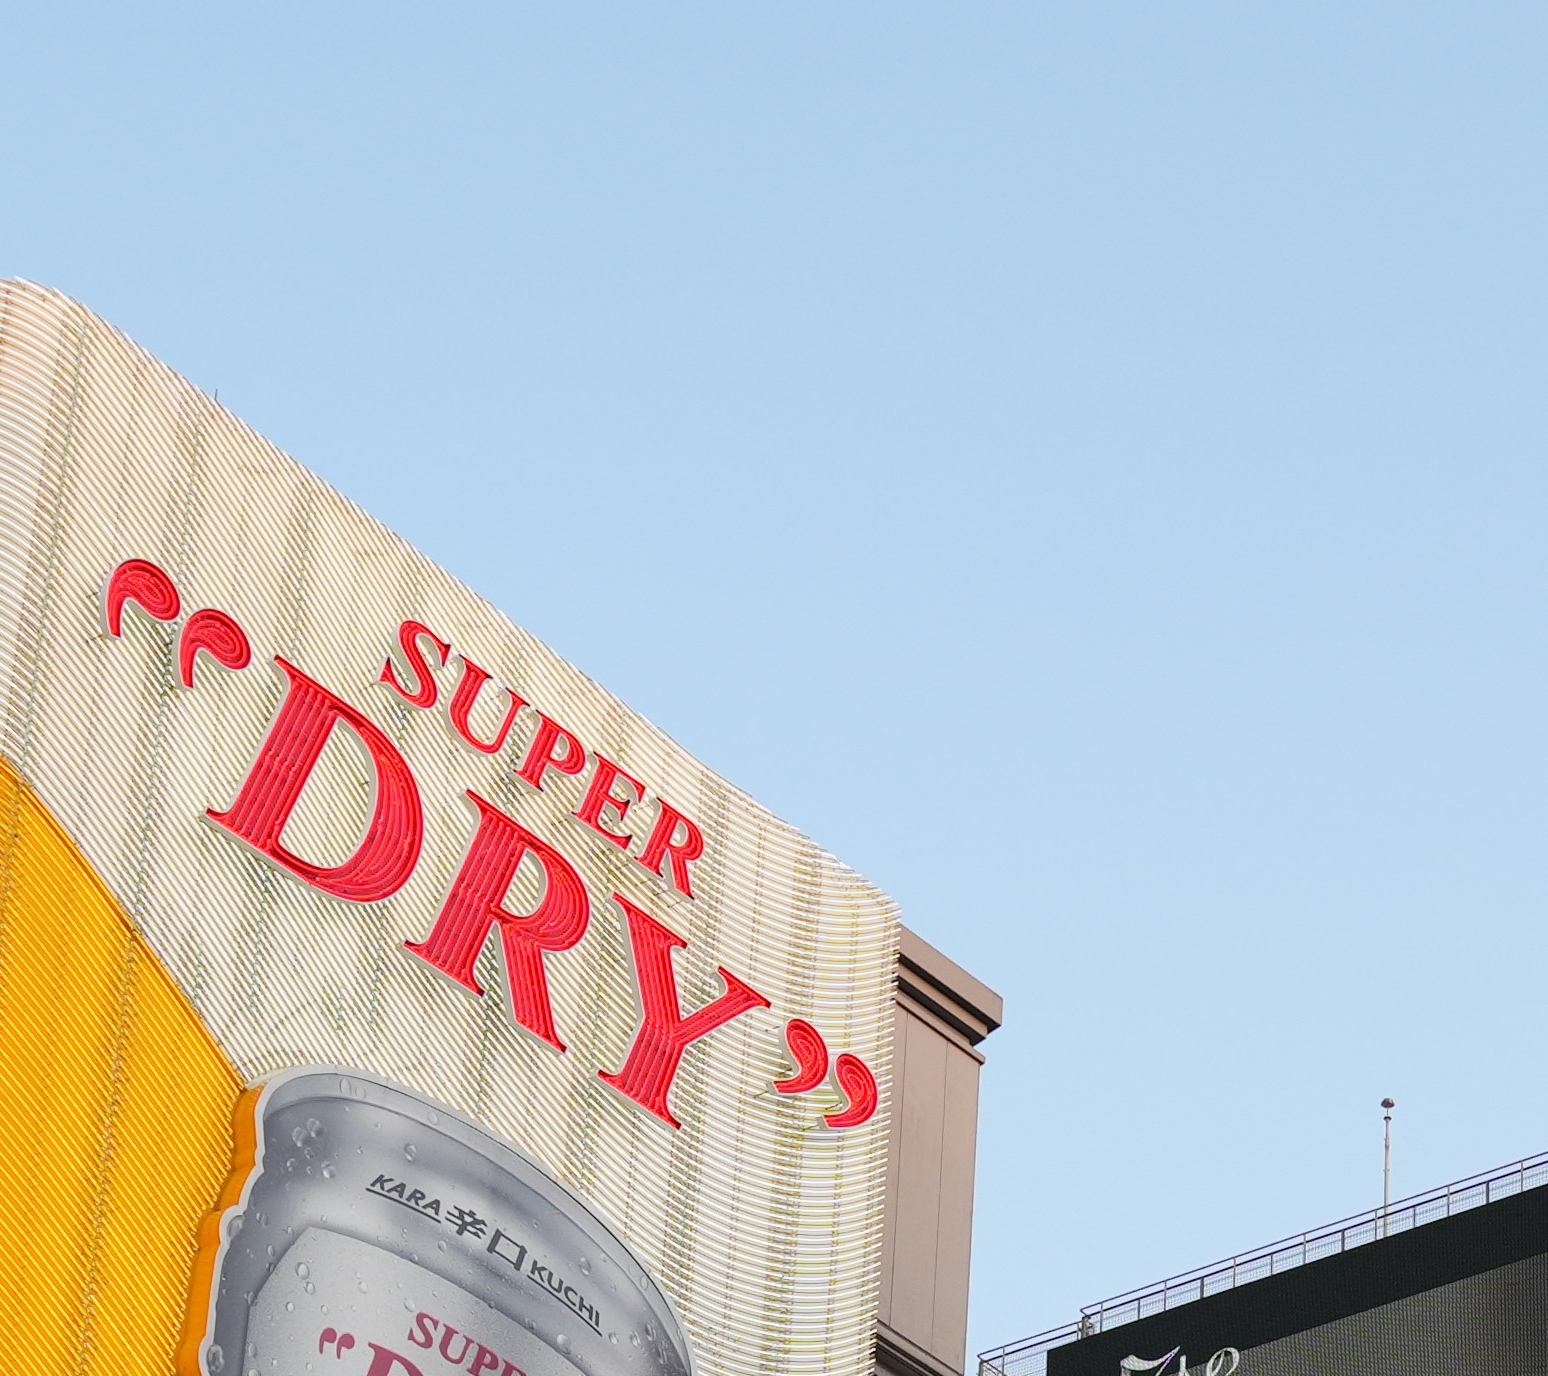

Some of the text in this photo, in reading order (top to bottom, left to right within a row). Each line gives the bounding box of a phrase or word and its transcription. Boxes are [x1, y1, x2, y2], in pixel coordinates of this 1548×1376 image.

[379, 619, 707, 900] SUPER
[370, 1174, 601, 1327] KARA 辛口 KUCHI
